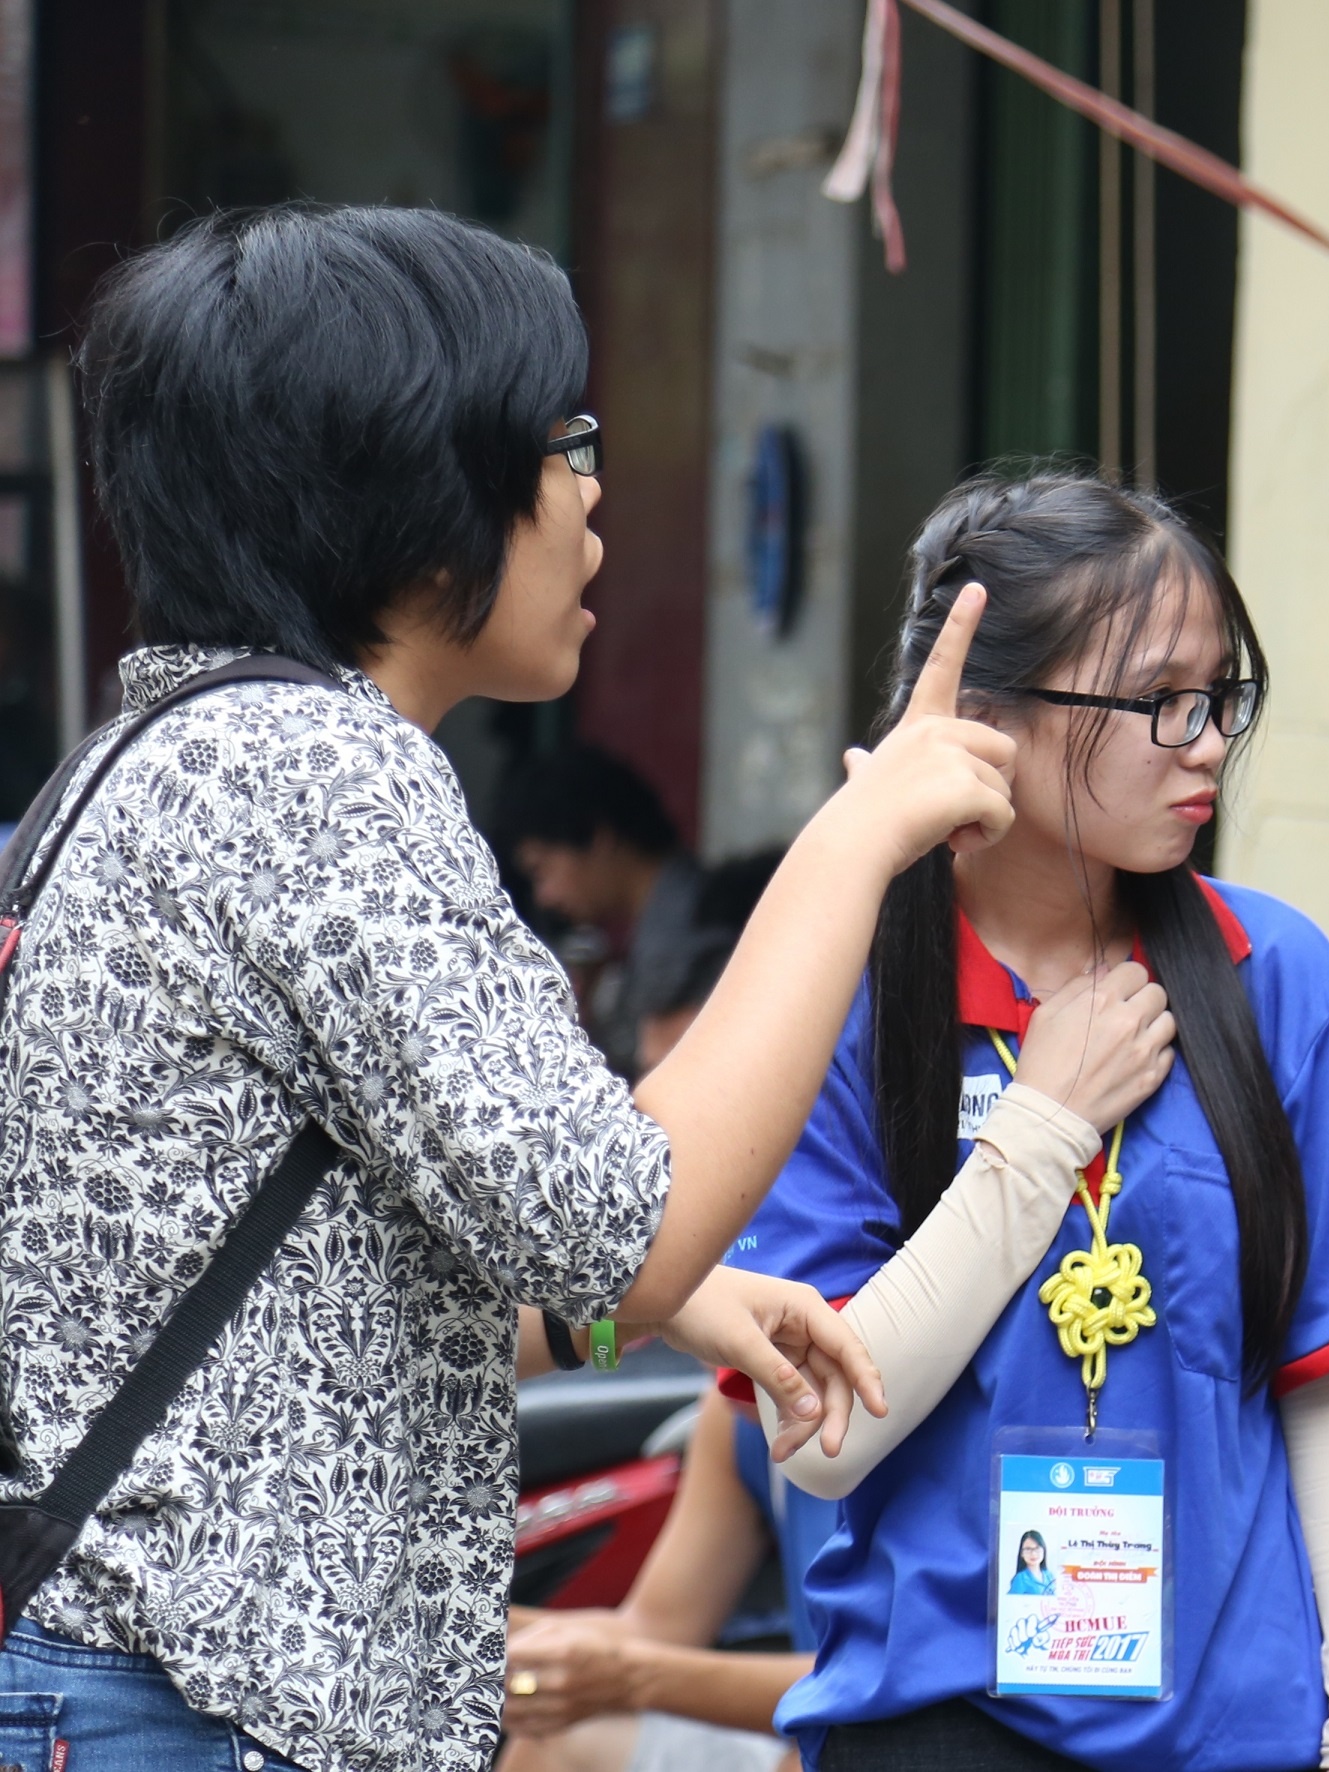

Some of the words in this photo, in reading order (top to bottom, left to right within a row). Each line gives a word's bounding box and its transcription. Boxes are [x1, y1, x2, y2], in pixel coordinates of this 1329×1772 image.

[737, 1235, 757, 1251] VN
[1122, 1541, 1152, 1552] Trang
[1065, 1615, 1128, 1633] HCMUE
[1092, 1633, 1147, 1660] 2017
